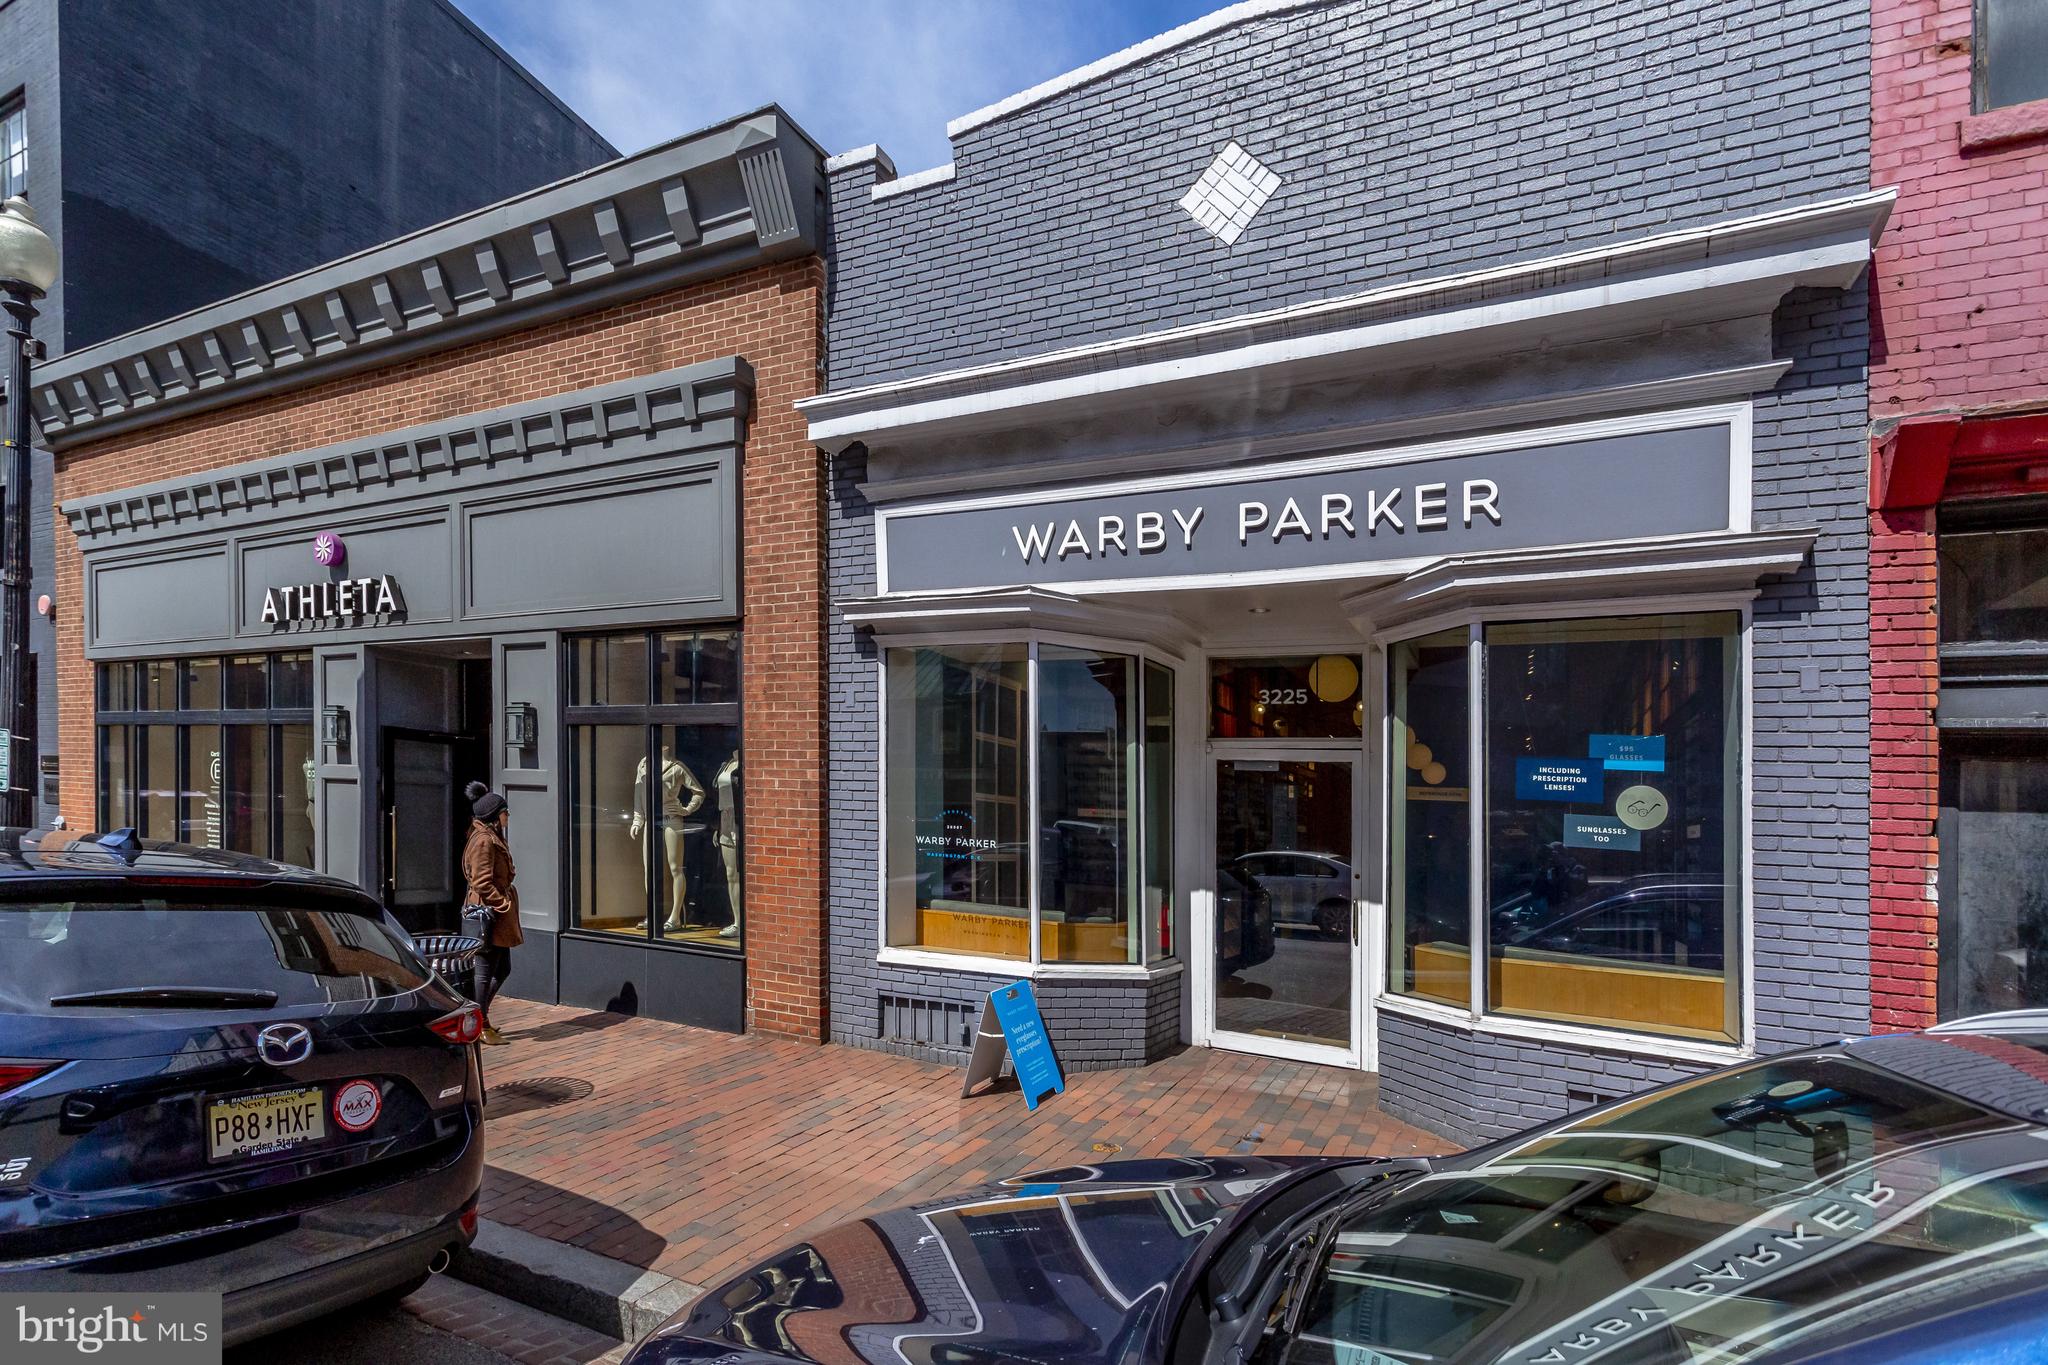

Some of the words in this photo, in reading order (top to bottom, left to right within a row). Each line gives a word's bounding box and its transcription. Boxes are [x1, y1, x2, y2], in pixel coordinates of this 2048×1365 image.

[1012, 506, 1203, 563] WARBY
[1238, 478, 1502, 542] PARKER
[261, 574, 403, 624] ATHLETA
[1258, 688, 1309, 705] 3225
[1609, 753, 1644, 761] GLASSES
[1539, 766, 1581, 775] INCLUDING
[1532, 775, 1587, 783] PRESCRIPTION
[1544, 783, 1575, 791] LENSES!
[1577, 825, 1627, 835] SUNGLASSES
[916, 835, 952, 846] WARBY
[956, 838, 997, 849] PARKER
[1593, 835, 1610, 843] TOO
[237, 1100, 263, 1111] New
[264, 1096, 297, 1109] Jersey
[343, 1098, 372, 1112] MAX
[215, 1112, 260, 1147] P88
[276, 1102, 317, 1136] HXF
[239, 1141, 273, 1154] Garden
[275, 1136, 300, 1148] State
